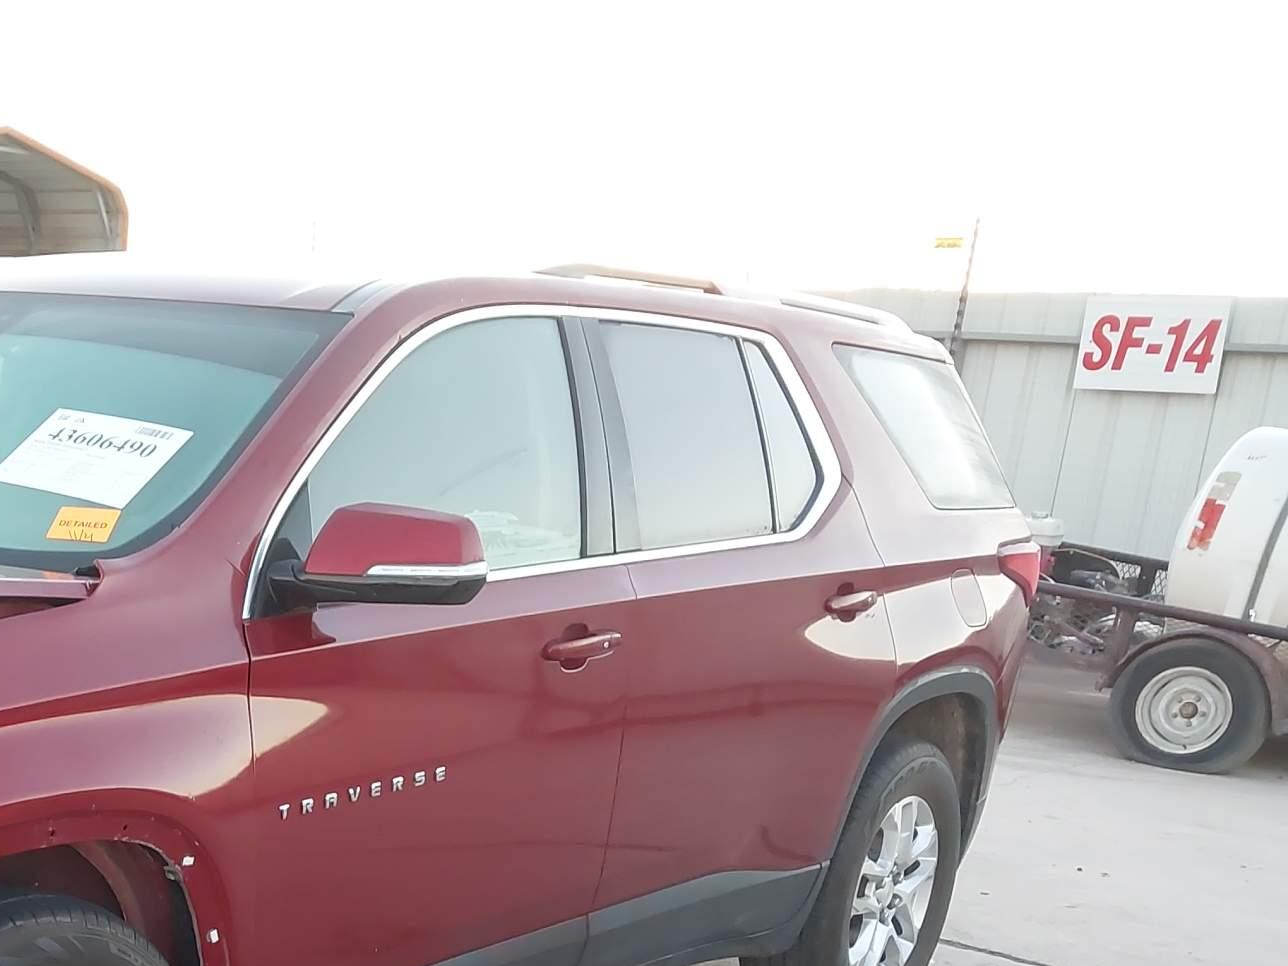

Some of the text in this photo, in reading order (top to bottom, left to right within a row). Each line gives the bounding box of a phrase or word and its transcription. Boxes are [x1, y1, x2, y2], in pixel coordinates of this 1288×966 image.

[1082, 314, 1223, 374] SF-14
[48, 427, 158, 458] 43606490
[58, 519, 109, 529] DETAILED
[278, 765, 447, 821] TRAVERSE
